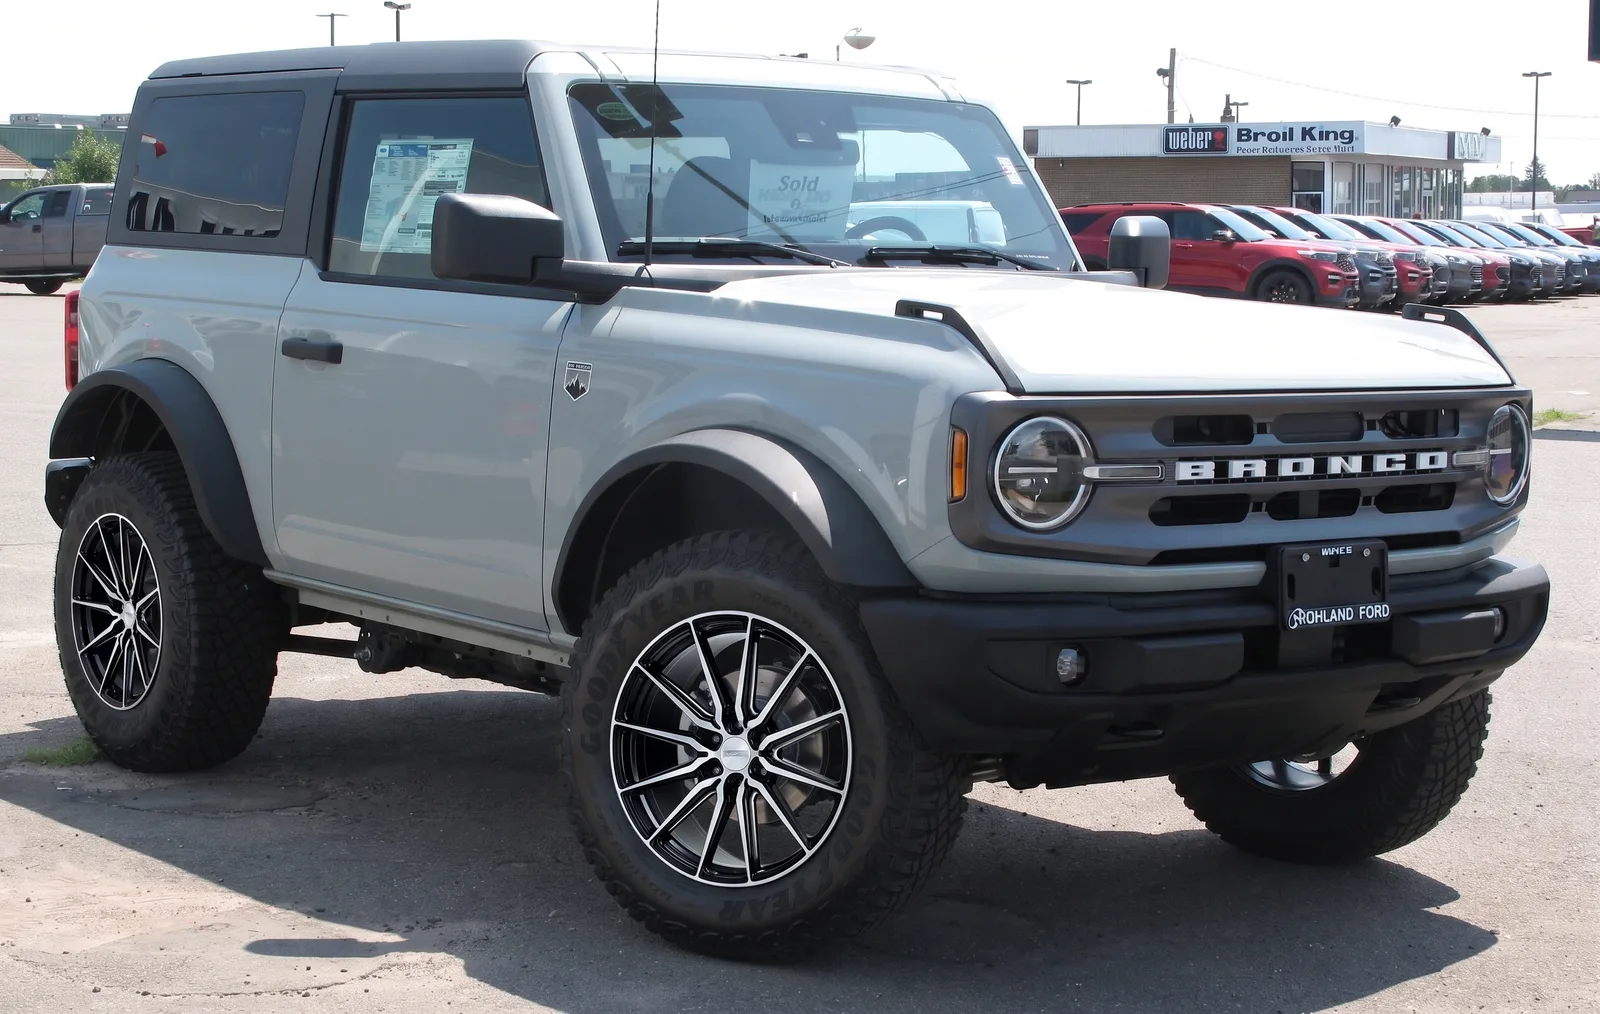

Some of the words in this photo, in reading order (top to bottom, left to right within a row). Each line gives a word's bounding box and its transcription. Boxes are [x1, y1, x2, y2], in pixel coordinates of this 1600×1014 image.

[1168, 127, 1212, 150] weber
[1236, 126, 1294, 142] Broil
[1300, 125, 1355, 144] King
[778, 175, 820, 192] Sold
[1175, 451, 1448, 481] BRONCO
[1359, 604, 1390, 620] FORD
[579, 579, 717, 755] GOODYEAR
